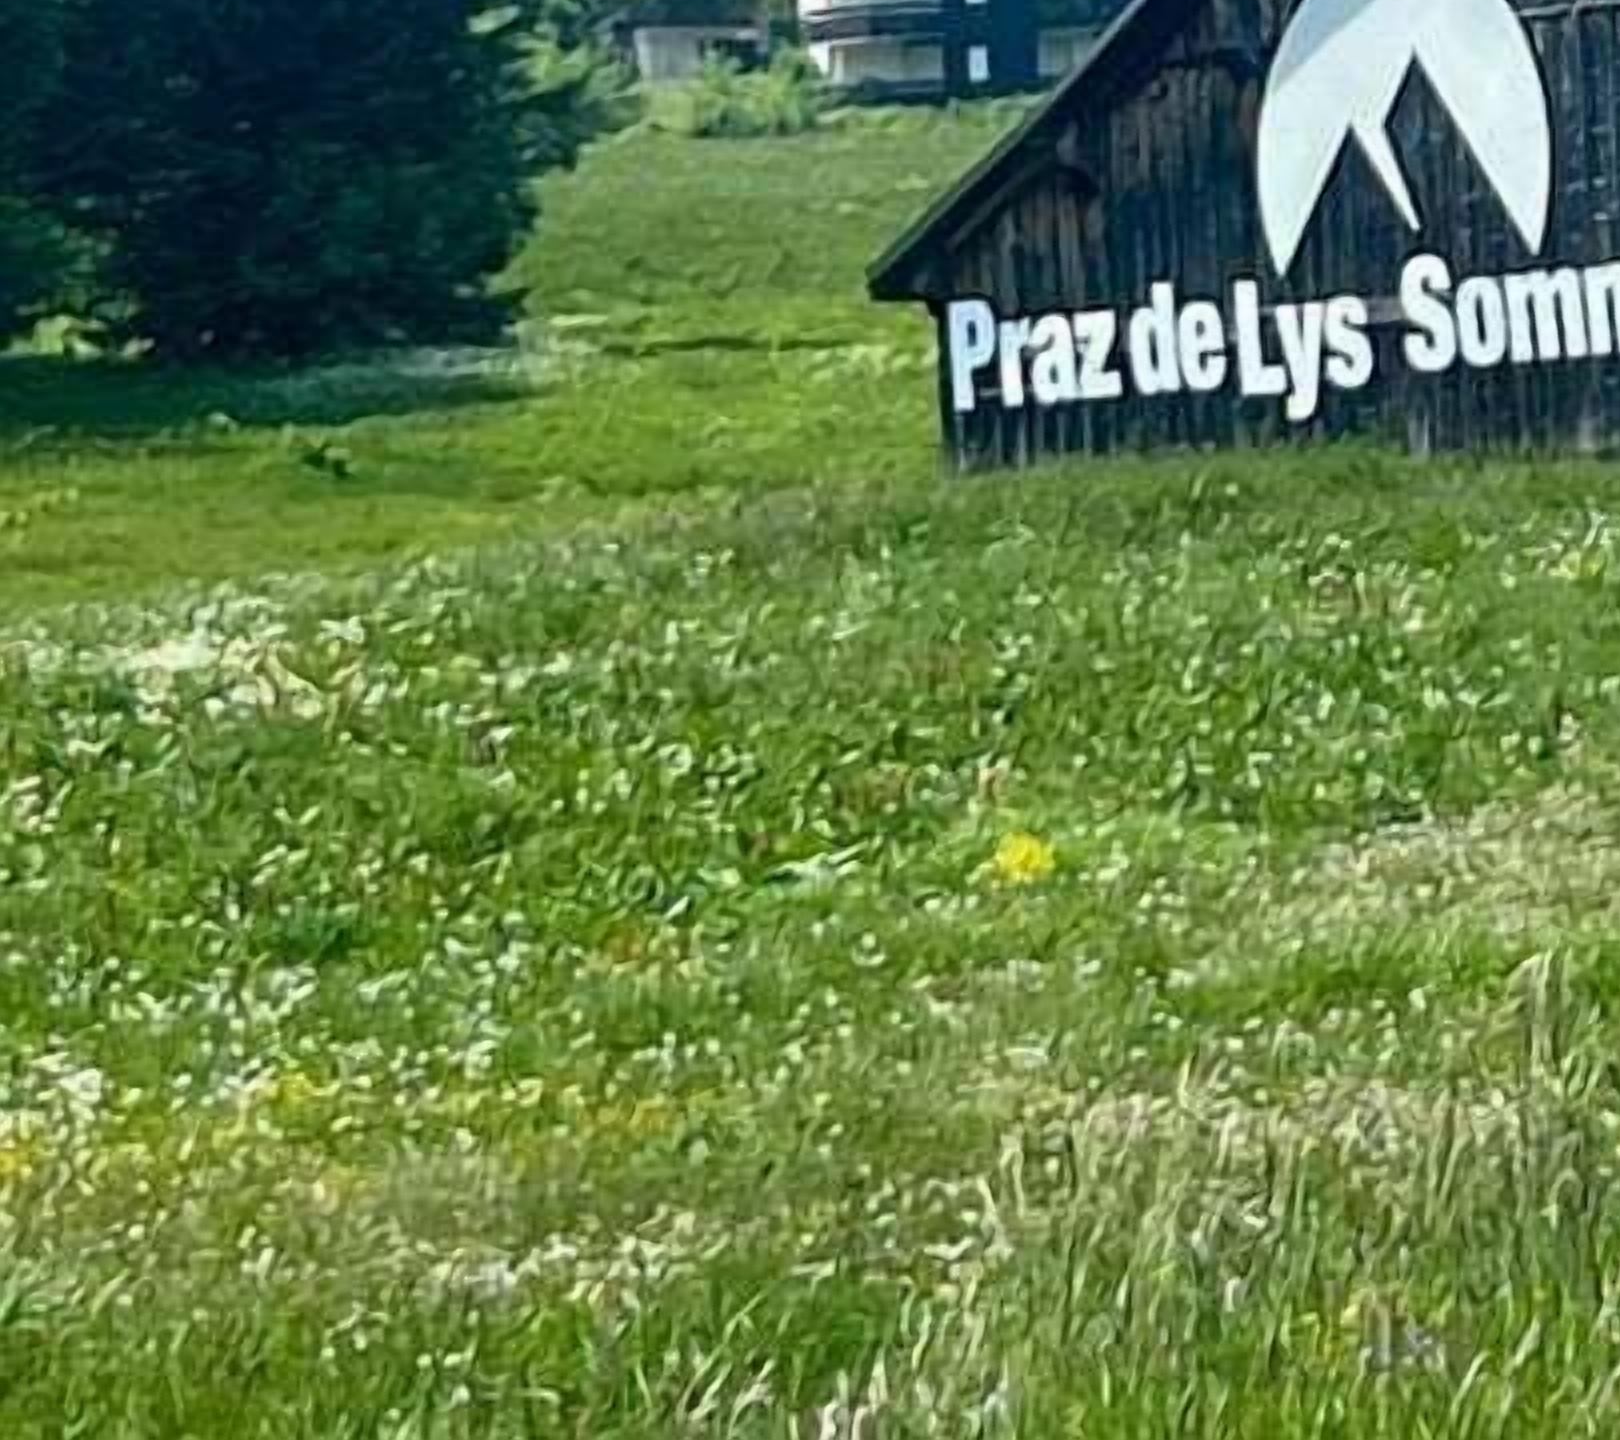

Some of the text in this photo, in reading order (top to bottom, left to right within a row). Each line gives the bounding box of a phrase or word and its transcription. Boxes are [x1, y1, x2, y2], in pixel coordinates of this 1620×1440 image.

[949, 299, 1124, 412] Praz
[1129, 281, 1227, 395] de
[1234, 280, 1374, 423] Lys
